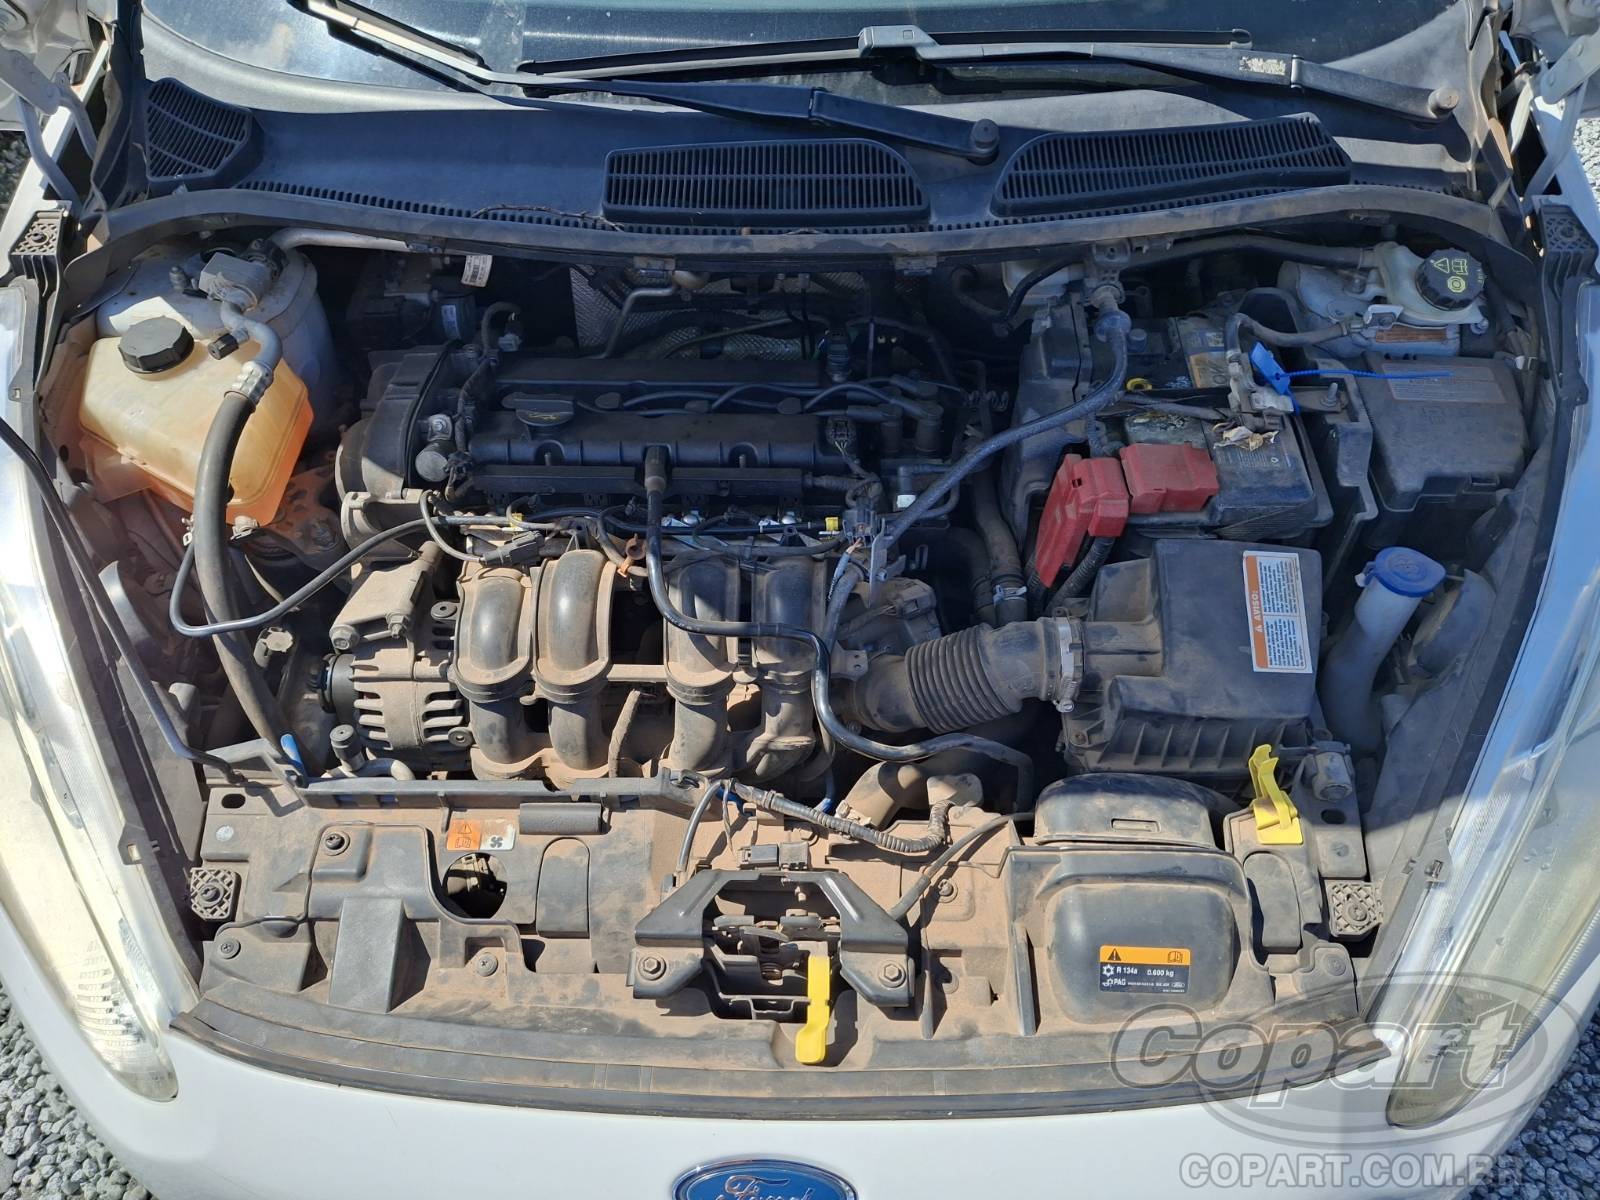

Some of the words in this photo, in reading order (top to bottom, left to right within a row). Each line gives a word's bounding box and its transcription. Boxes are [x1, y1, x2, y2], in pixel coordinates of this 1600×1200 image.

[1252, 591, 1262, 620] AVISO:
[1116, 966, 1122, 974] R
[1123, 967, 1138, 975] 134a
[1165, 970, 1174, 978] kg
[1113, 978, 1126, 986] PAG
